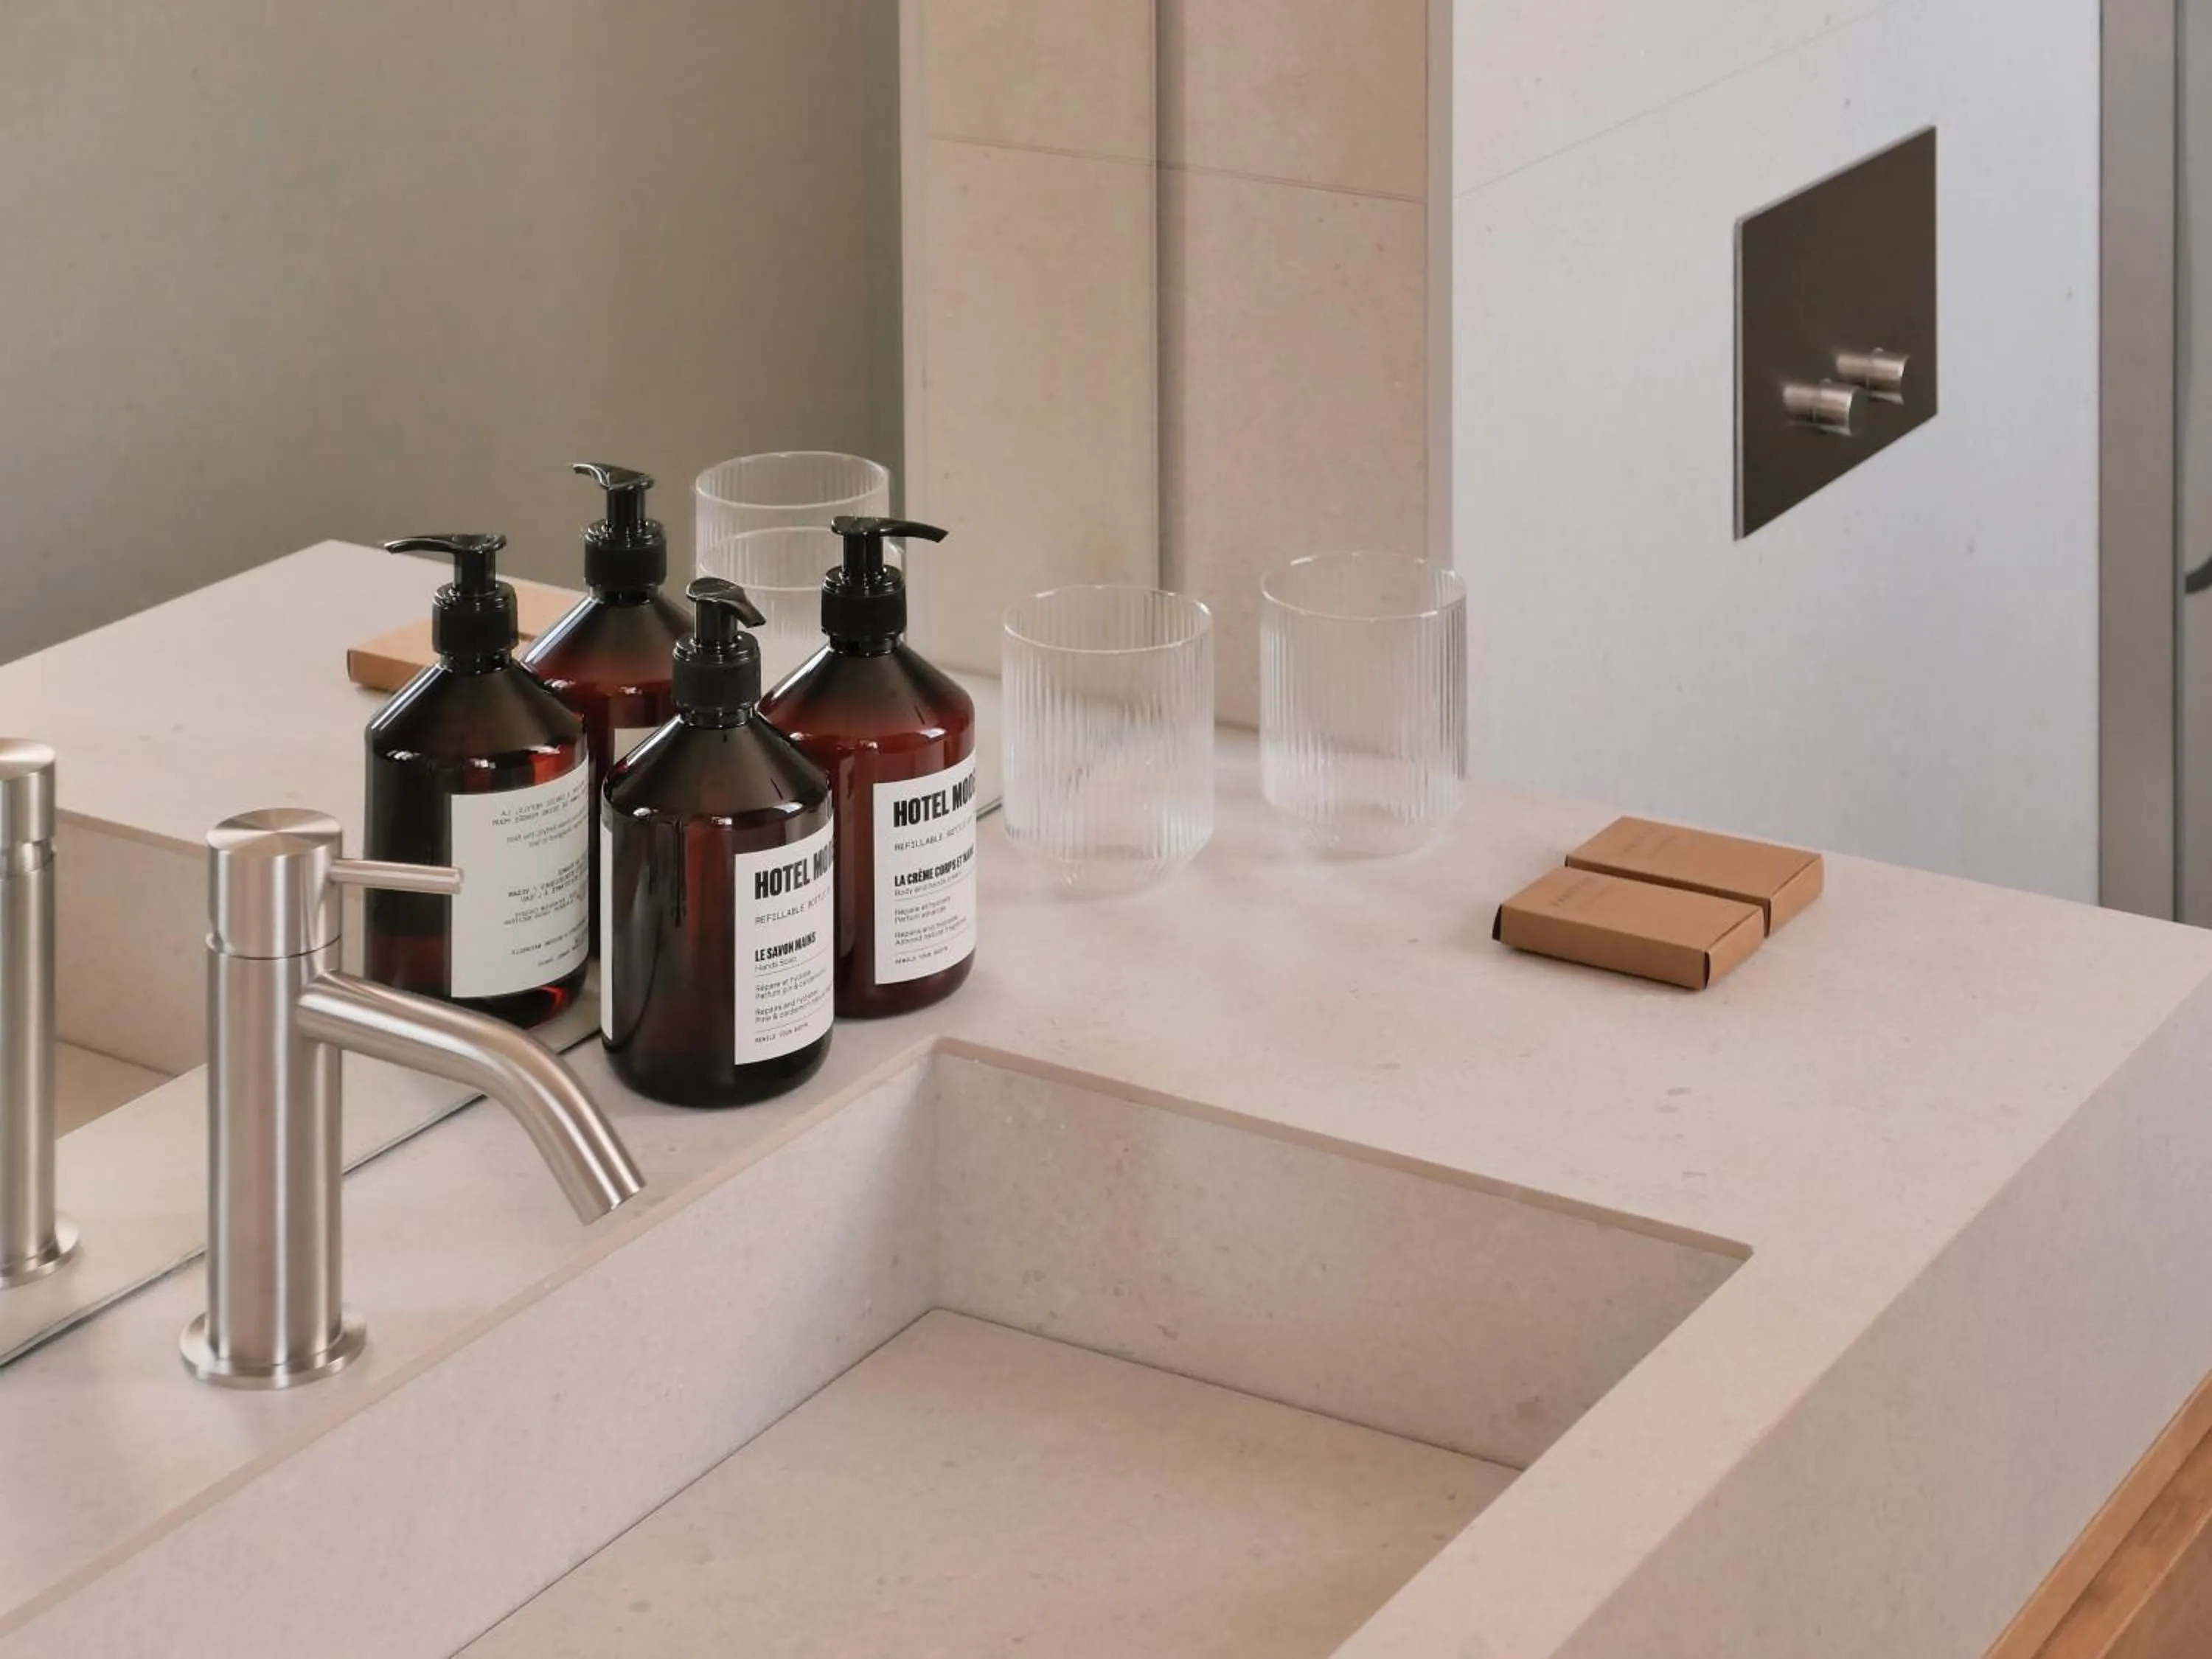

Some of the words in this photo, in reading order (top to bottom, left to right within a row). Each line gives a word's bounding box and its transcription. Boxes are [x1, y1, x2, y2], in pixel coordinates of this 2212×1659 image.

[893, 790, 950, 828] HOTEL
[894, 832, 943, 851] REFILLABLE
[754, 858, 810, 900] HOTEL
[894, 874, 906, 887] LA
[934, 858, 956, 877] CORPS
[755, 903, 804, 925] REFILLABLE
[755, 948, 765, 962] LE
[766, 940, 794, 959] SAVON
[794, 931, 816, 951] MAINS
